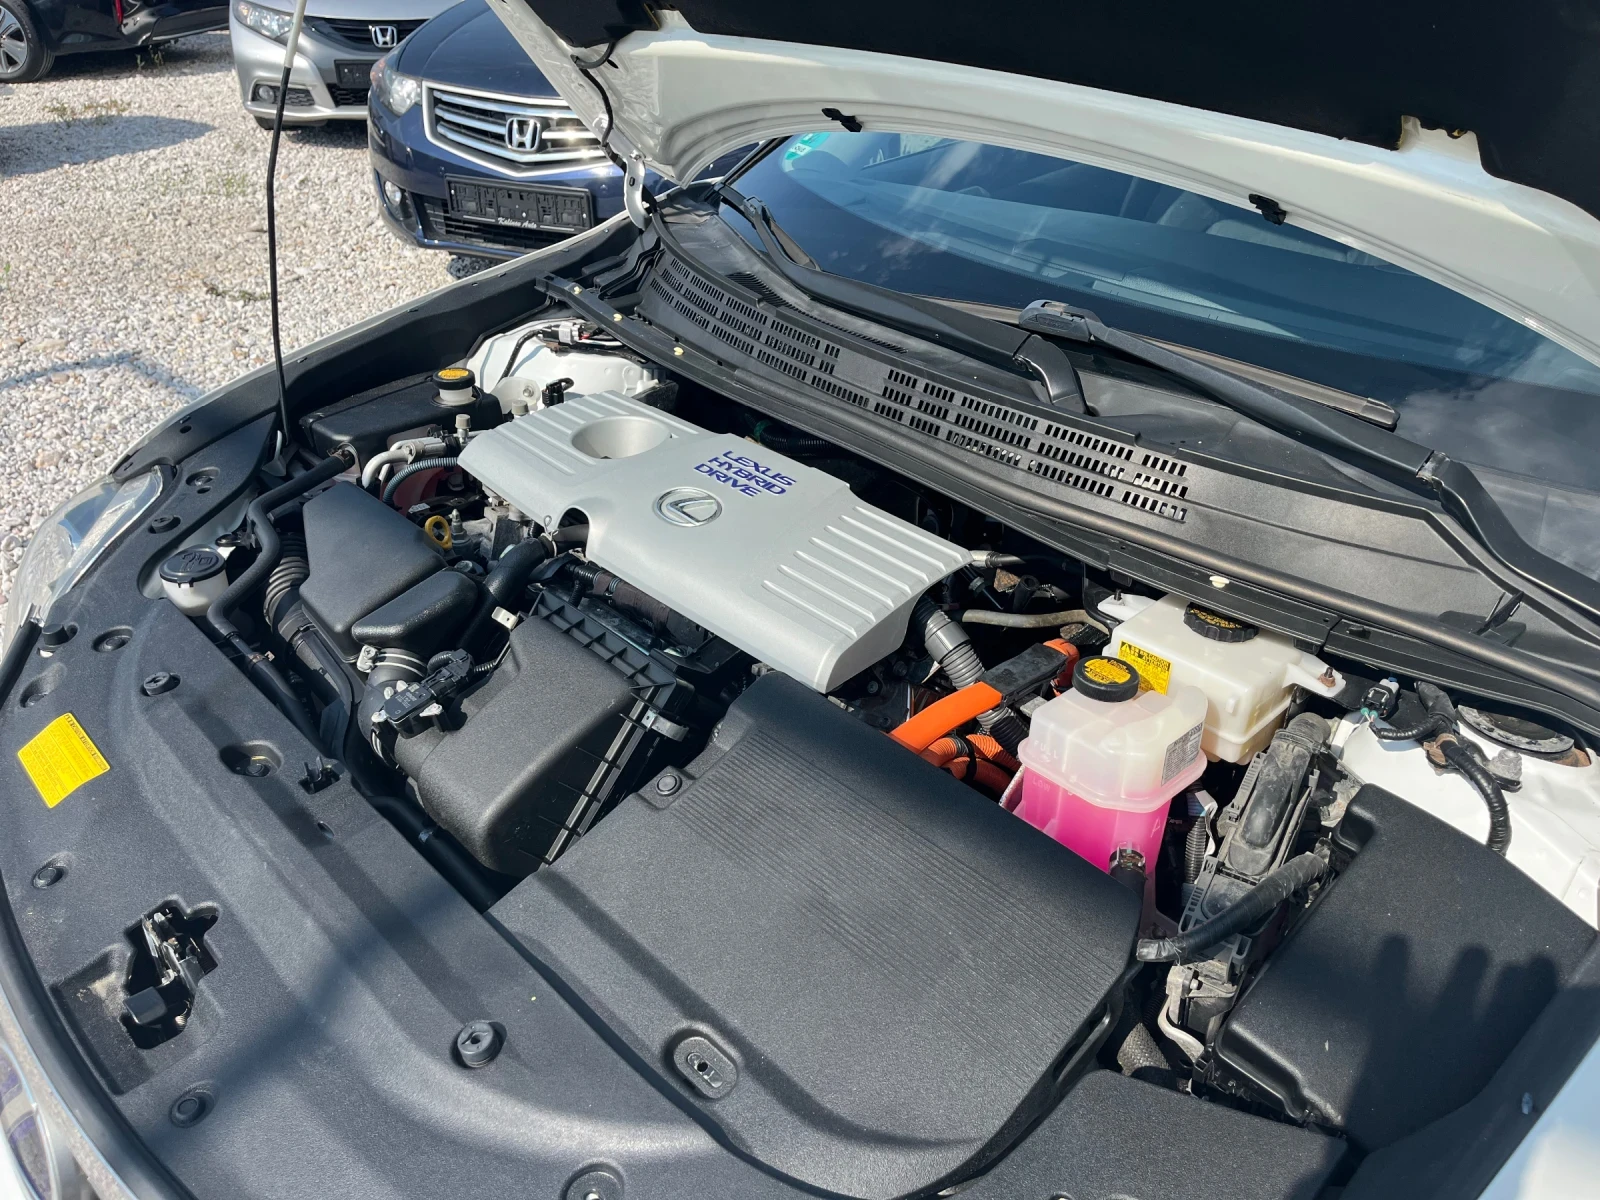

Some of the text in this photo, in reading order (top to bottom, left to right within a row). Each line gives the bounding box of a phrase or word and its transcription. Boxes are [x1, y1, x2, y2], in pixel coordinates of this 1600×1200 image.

[522, 220, 537, 229] Auto
[694, 463, 762, 497] DRIVE
[708, 457, 786, 495] HYBRID
[722, 450, 797, 486] LEXUS
